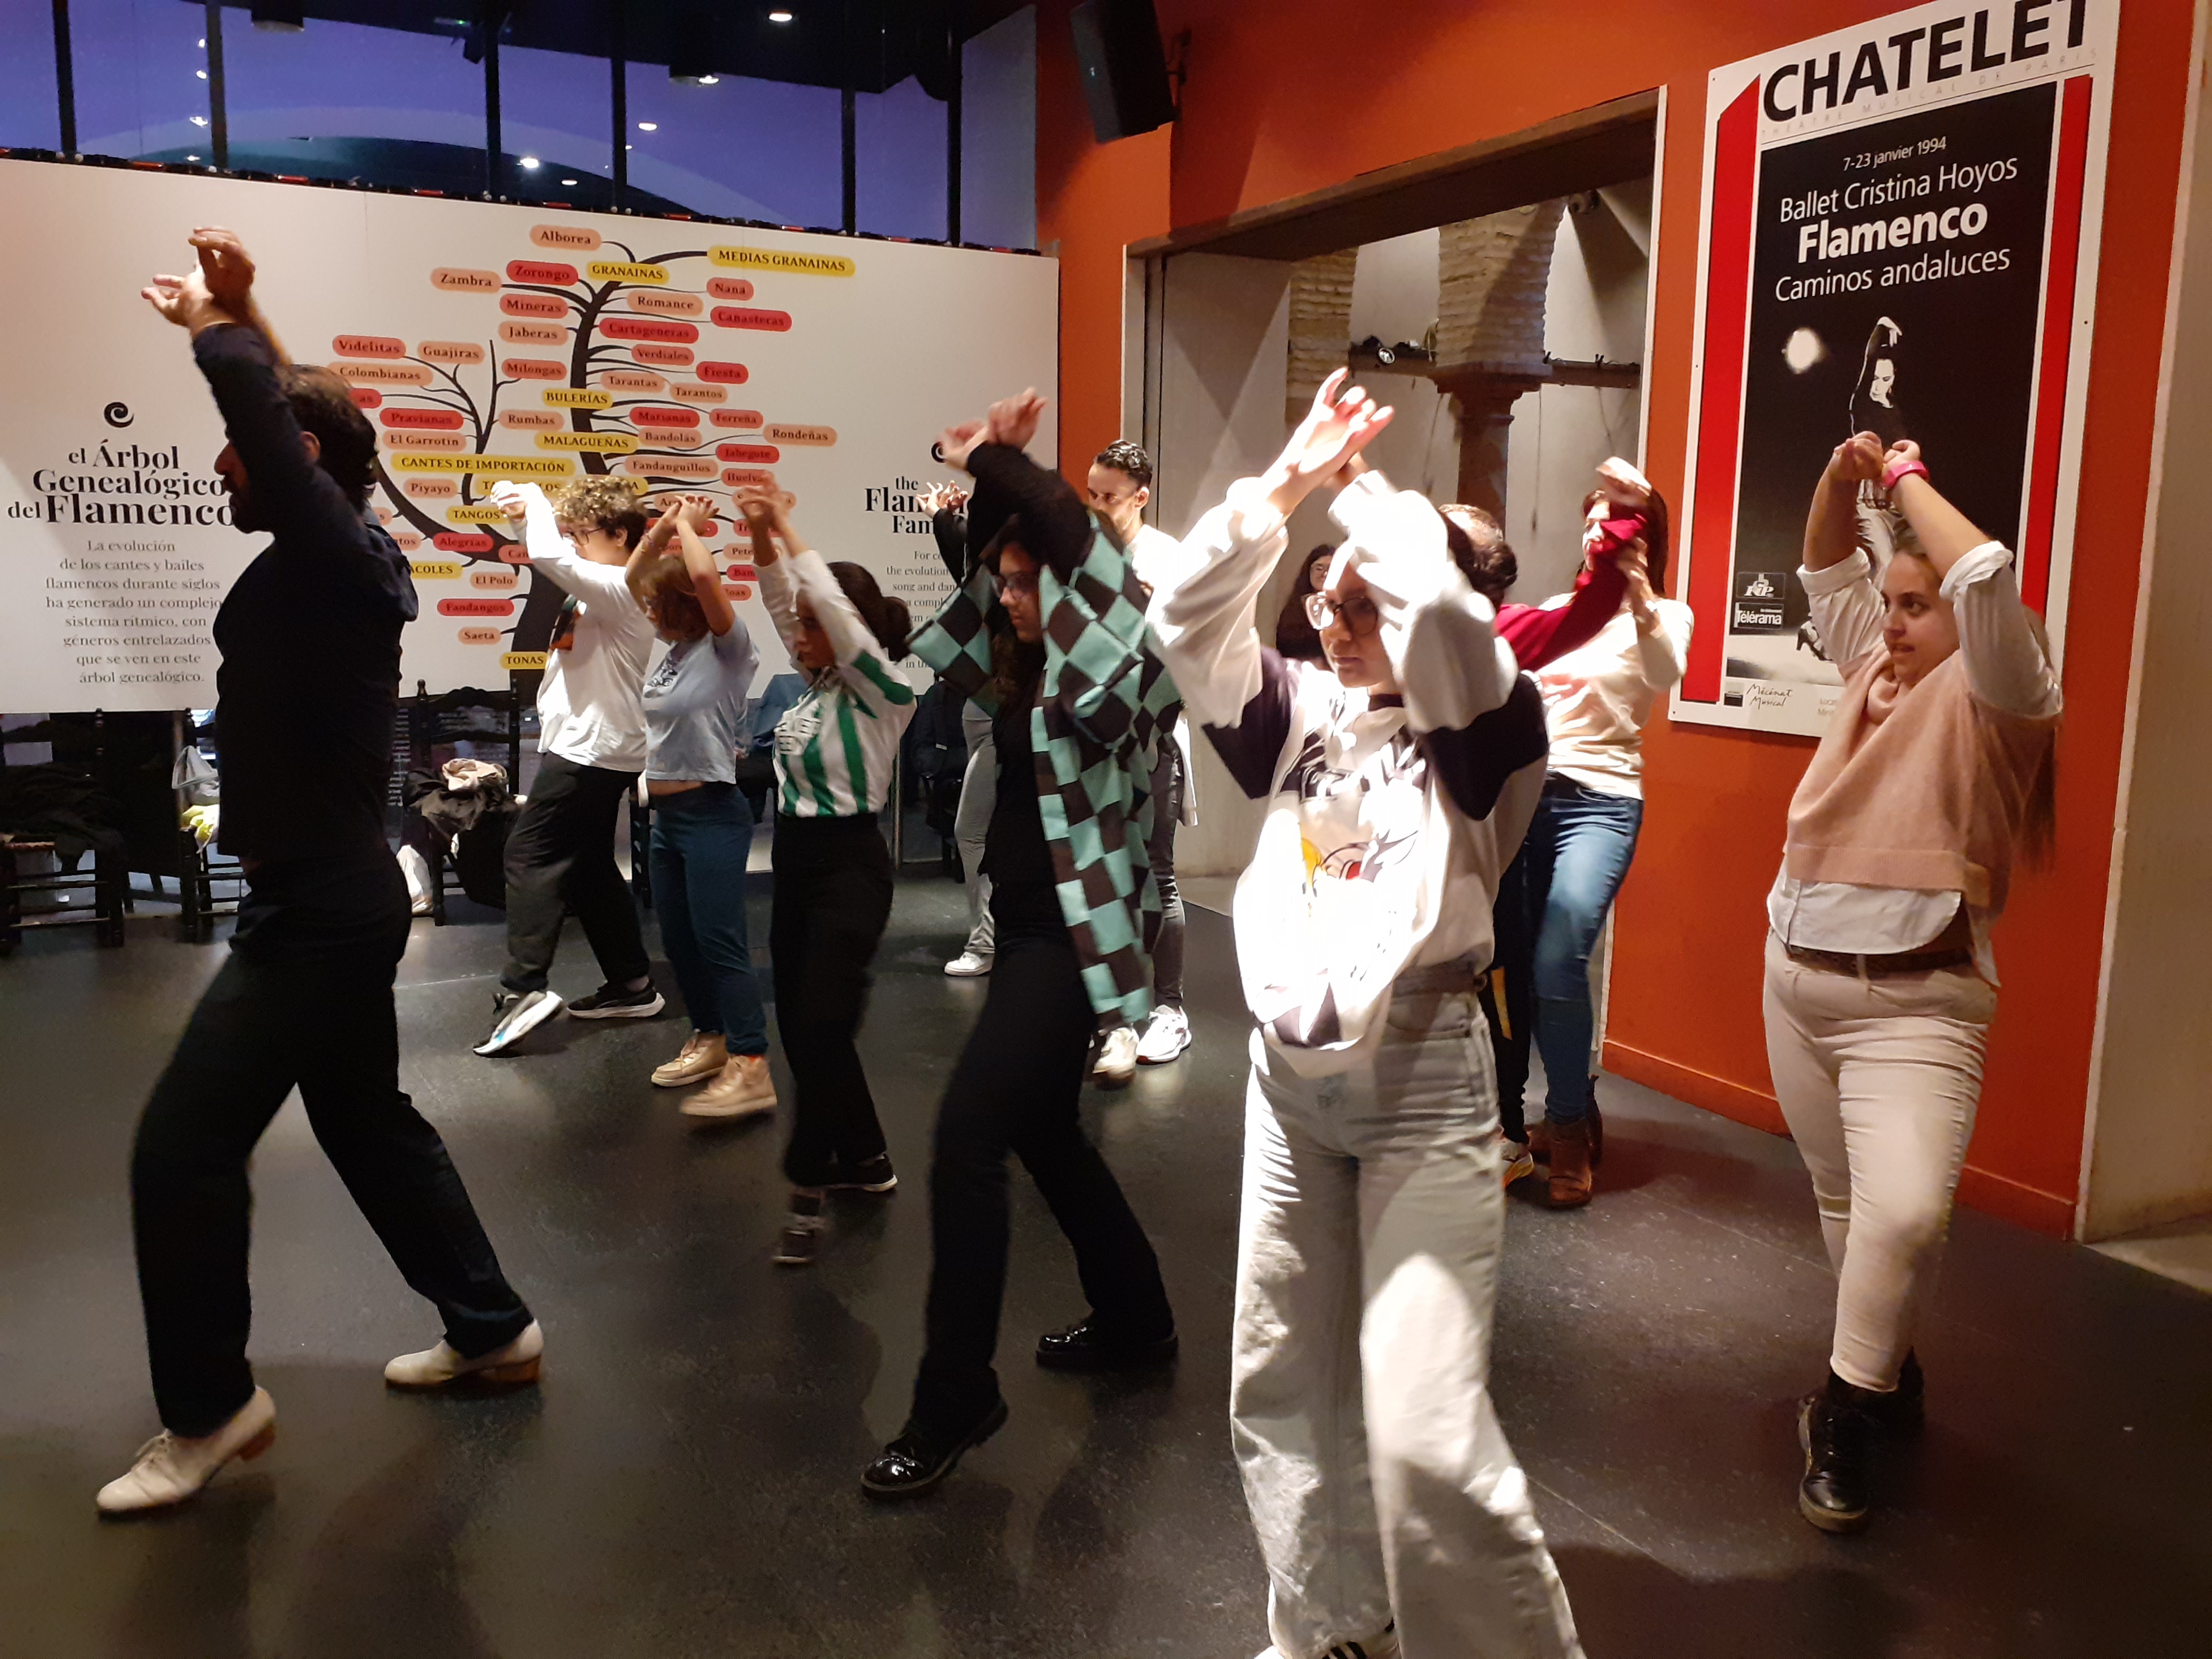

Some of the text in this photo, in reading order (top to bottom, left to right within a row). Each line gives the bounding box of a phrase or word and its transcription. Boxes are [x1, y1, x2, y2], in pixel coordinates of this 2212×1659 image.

[1763, 0, 2086, 123] CHATELET
[1843, 136, 1946, 171] 7-23 janvier 1994
[1780, 158, 2018, 223] Ballet Cristina Hoyos
[541, 231, 591, 244] Alborea
[1798, 203, 1987, 264] Flamenco
[718, 250, 845, 271] MEDIAS GRANAINAS
[515, 265, 570, 281] Zorongo
[592, 265, 663, 279] GRANAINAS
[1775, 248, 2010, 301] Caminos andaluces
[440, 273, 492, 287] Zambra
[715, 283, 745, 294] Nana
[506, 300, 562, 312] Mineras
[638, 297, 693, 309] Romance
[509, 326, 557, 339] Jaberas
[609, 324, 690, 338] Cartageneras
[423, 346, 479, 359] Guajiras
[637, 349, 689, 360] Verdiales
[340, 367, 421, 380] Colombianas
[506, 363, 562, 377] Milongas
[704, 366, 741, 378] Fiesta
[609, 376, 657, 387] Tarantas
[546, 390, 608, 405] BULERÍAS
[676, 387, 722, 398] Tarantos
[508, 414, 555, 425] Rumbas
[639, 412, 691, 423] Marianas
[391, 435, 402, 444] El
[544, 435, 629, 447] MALAGUEÑAS
[773, 429, 827, 441] Rondeñas
[69, 439, 179, 469] el Árbol
[401, 458, 565, 472] CANTES DE IMPORTACIÓN
[633, 461, 710, 473] Fandanguillos
[33, 469, 226, 500] Genealógico
[411, 483, 450, 494] Piyayo
[895, 476, 918, 490] the
[8, 494, 234, 526] del Flamenco
[454, 510, 500, 519] TANGOS
[88, 540, 175, 551] La evolución
[914, 551, 930, 559] For
[60, 559, 204, 572] de los cantes y bailes
[887, 566, 948, 576] the evolution
[46, 578, 220, 590] flamencos durante siglos
[475, 576, 513, 585] El Polo
[893, 582, 955, 592] song and dan
[46, 597, 222, 609] ha generado un complejo
[446, 603, 505, 614] Fandangos
[65, 616, 118, 626] sistema
[183, 618, 206, 626] con
[1736, 610, 1782, 625] Télérama
[63, 634, 211, 647] géneros entrelazados
[464, 632, 494, 640] Saeta
[77, 656, 101, 666] que
[174, 654, 200, 663] este
[906, 659, 914, 668] in
[80, 671, 204, 683] árbol genealógico.
[1750, 696, 1787, 709] Musical
